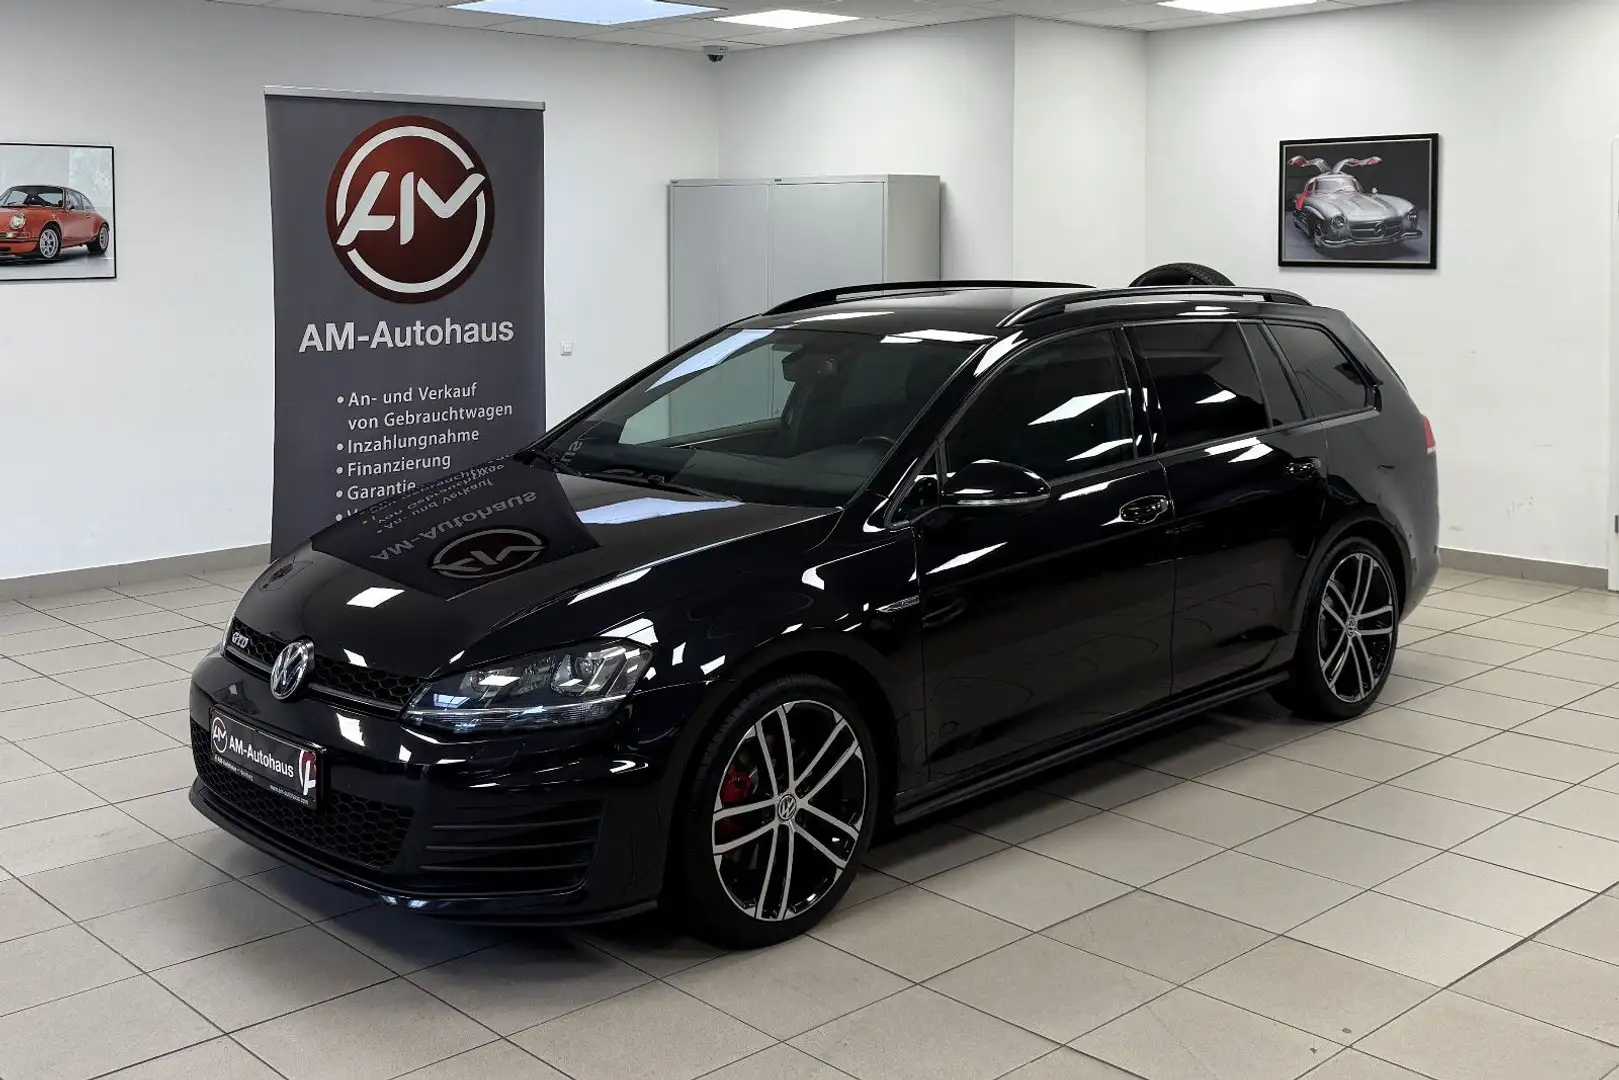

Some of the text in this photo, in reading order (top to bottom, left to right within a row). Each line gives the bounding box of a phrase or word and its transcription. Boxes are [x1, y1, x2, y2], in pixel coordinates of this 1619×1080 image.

[299, 318, 515, 353] AM-Autohaus
[348, 382, 478, 407] An- und Verkauf
[348, 403, 513, 430] von Gebrauchtwagen
[347, 428, 480, 454] Inzahlungnahme
[347, 454, 451, 477] Finanzierung
[347, 479, 416, 500] Garantie
[229, 735, 294, 778] AM-Autohaus
